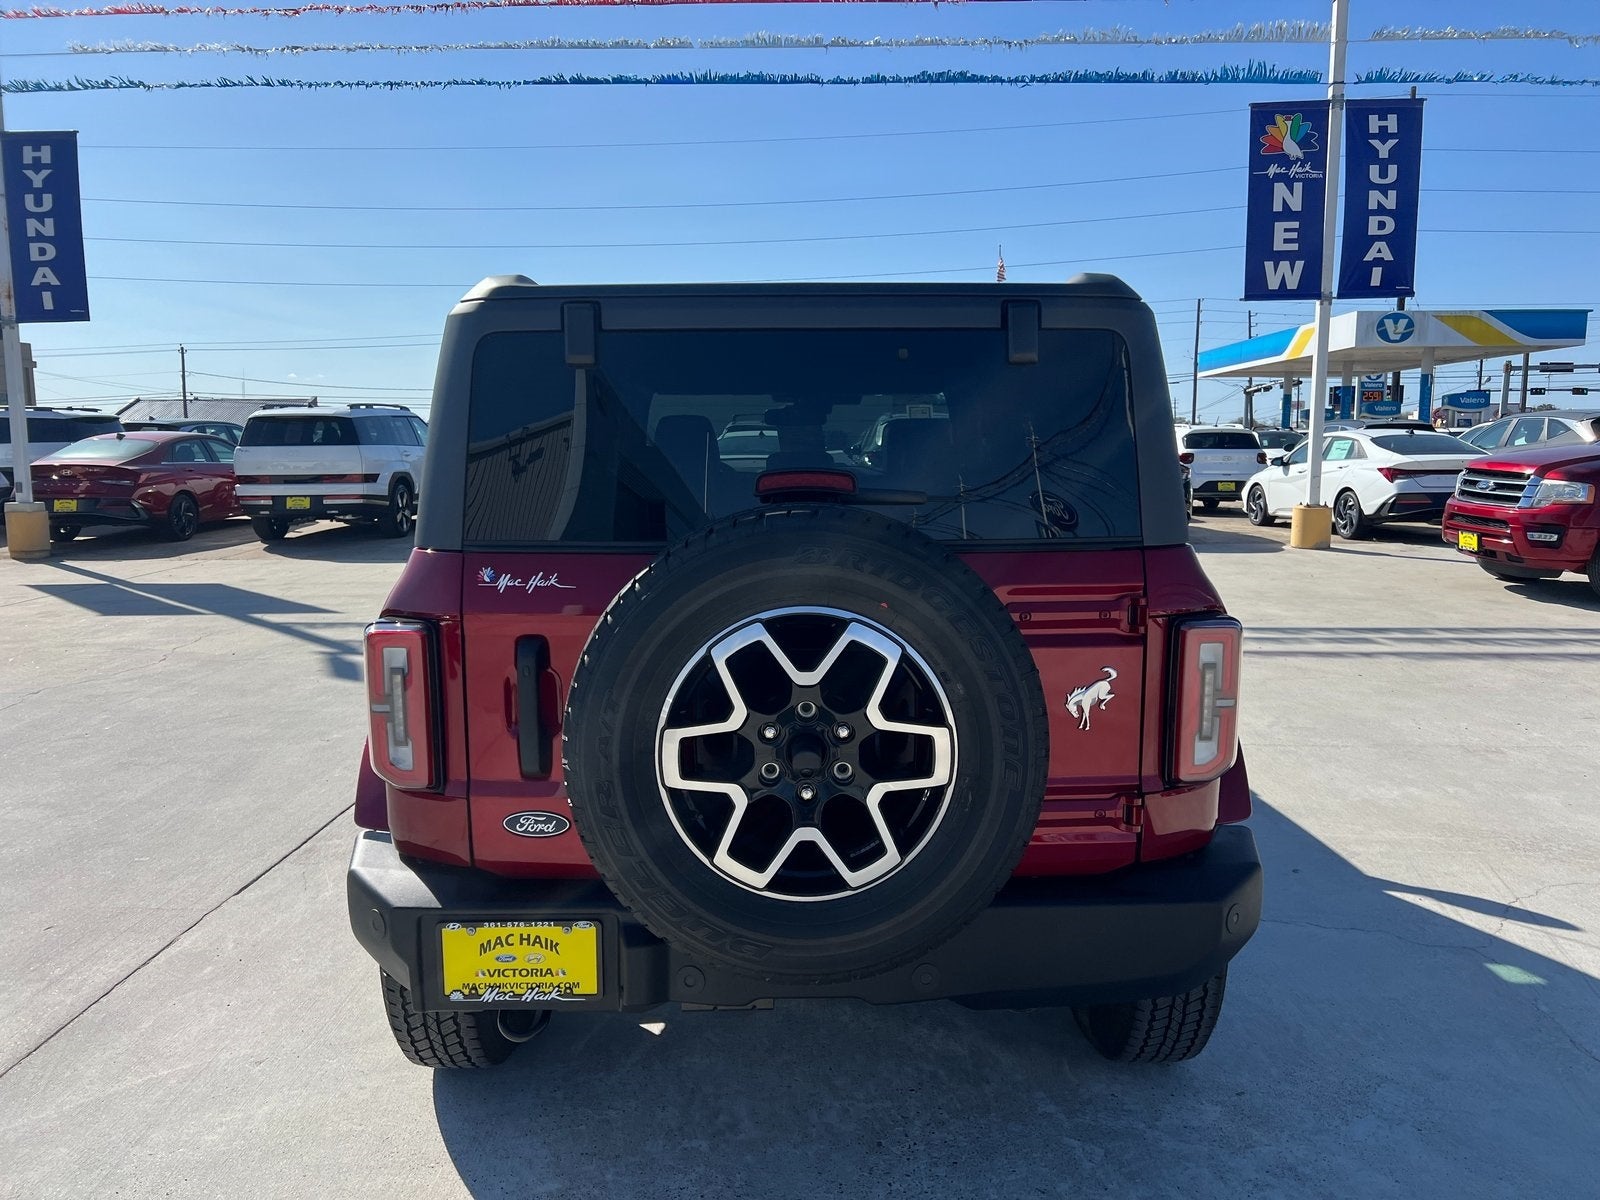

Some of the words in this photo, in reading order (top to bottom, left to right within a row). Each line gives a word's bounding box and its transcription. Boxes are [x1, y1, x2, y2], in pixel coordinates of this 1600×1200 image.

[1266, 163, 1289, 179] Mac
[1288, 161, 1317, 179] Haik
[1362, 113, 1398, 287] HYUNDAI
[22, 145, 61, 311] HYUNDAI
[1263, 182, 1305, 291] NEW
[496, 573, 526, 594] Mac
[525, 571, 566, 594] Haik
[516, 815, 556, 833] Ford
[479, 933, 515, 957] MAC
[519, 933, 561, 956] HAIK
[486, 968, 555, 978] VICTORIA
[480, 986, 520, 1003] Mac
[520, 986, 569, 1003] Haik
